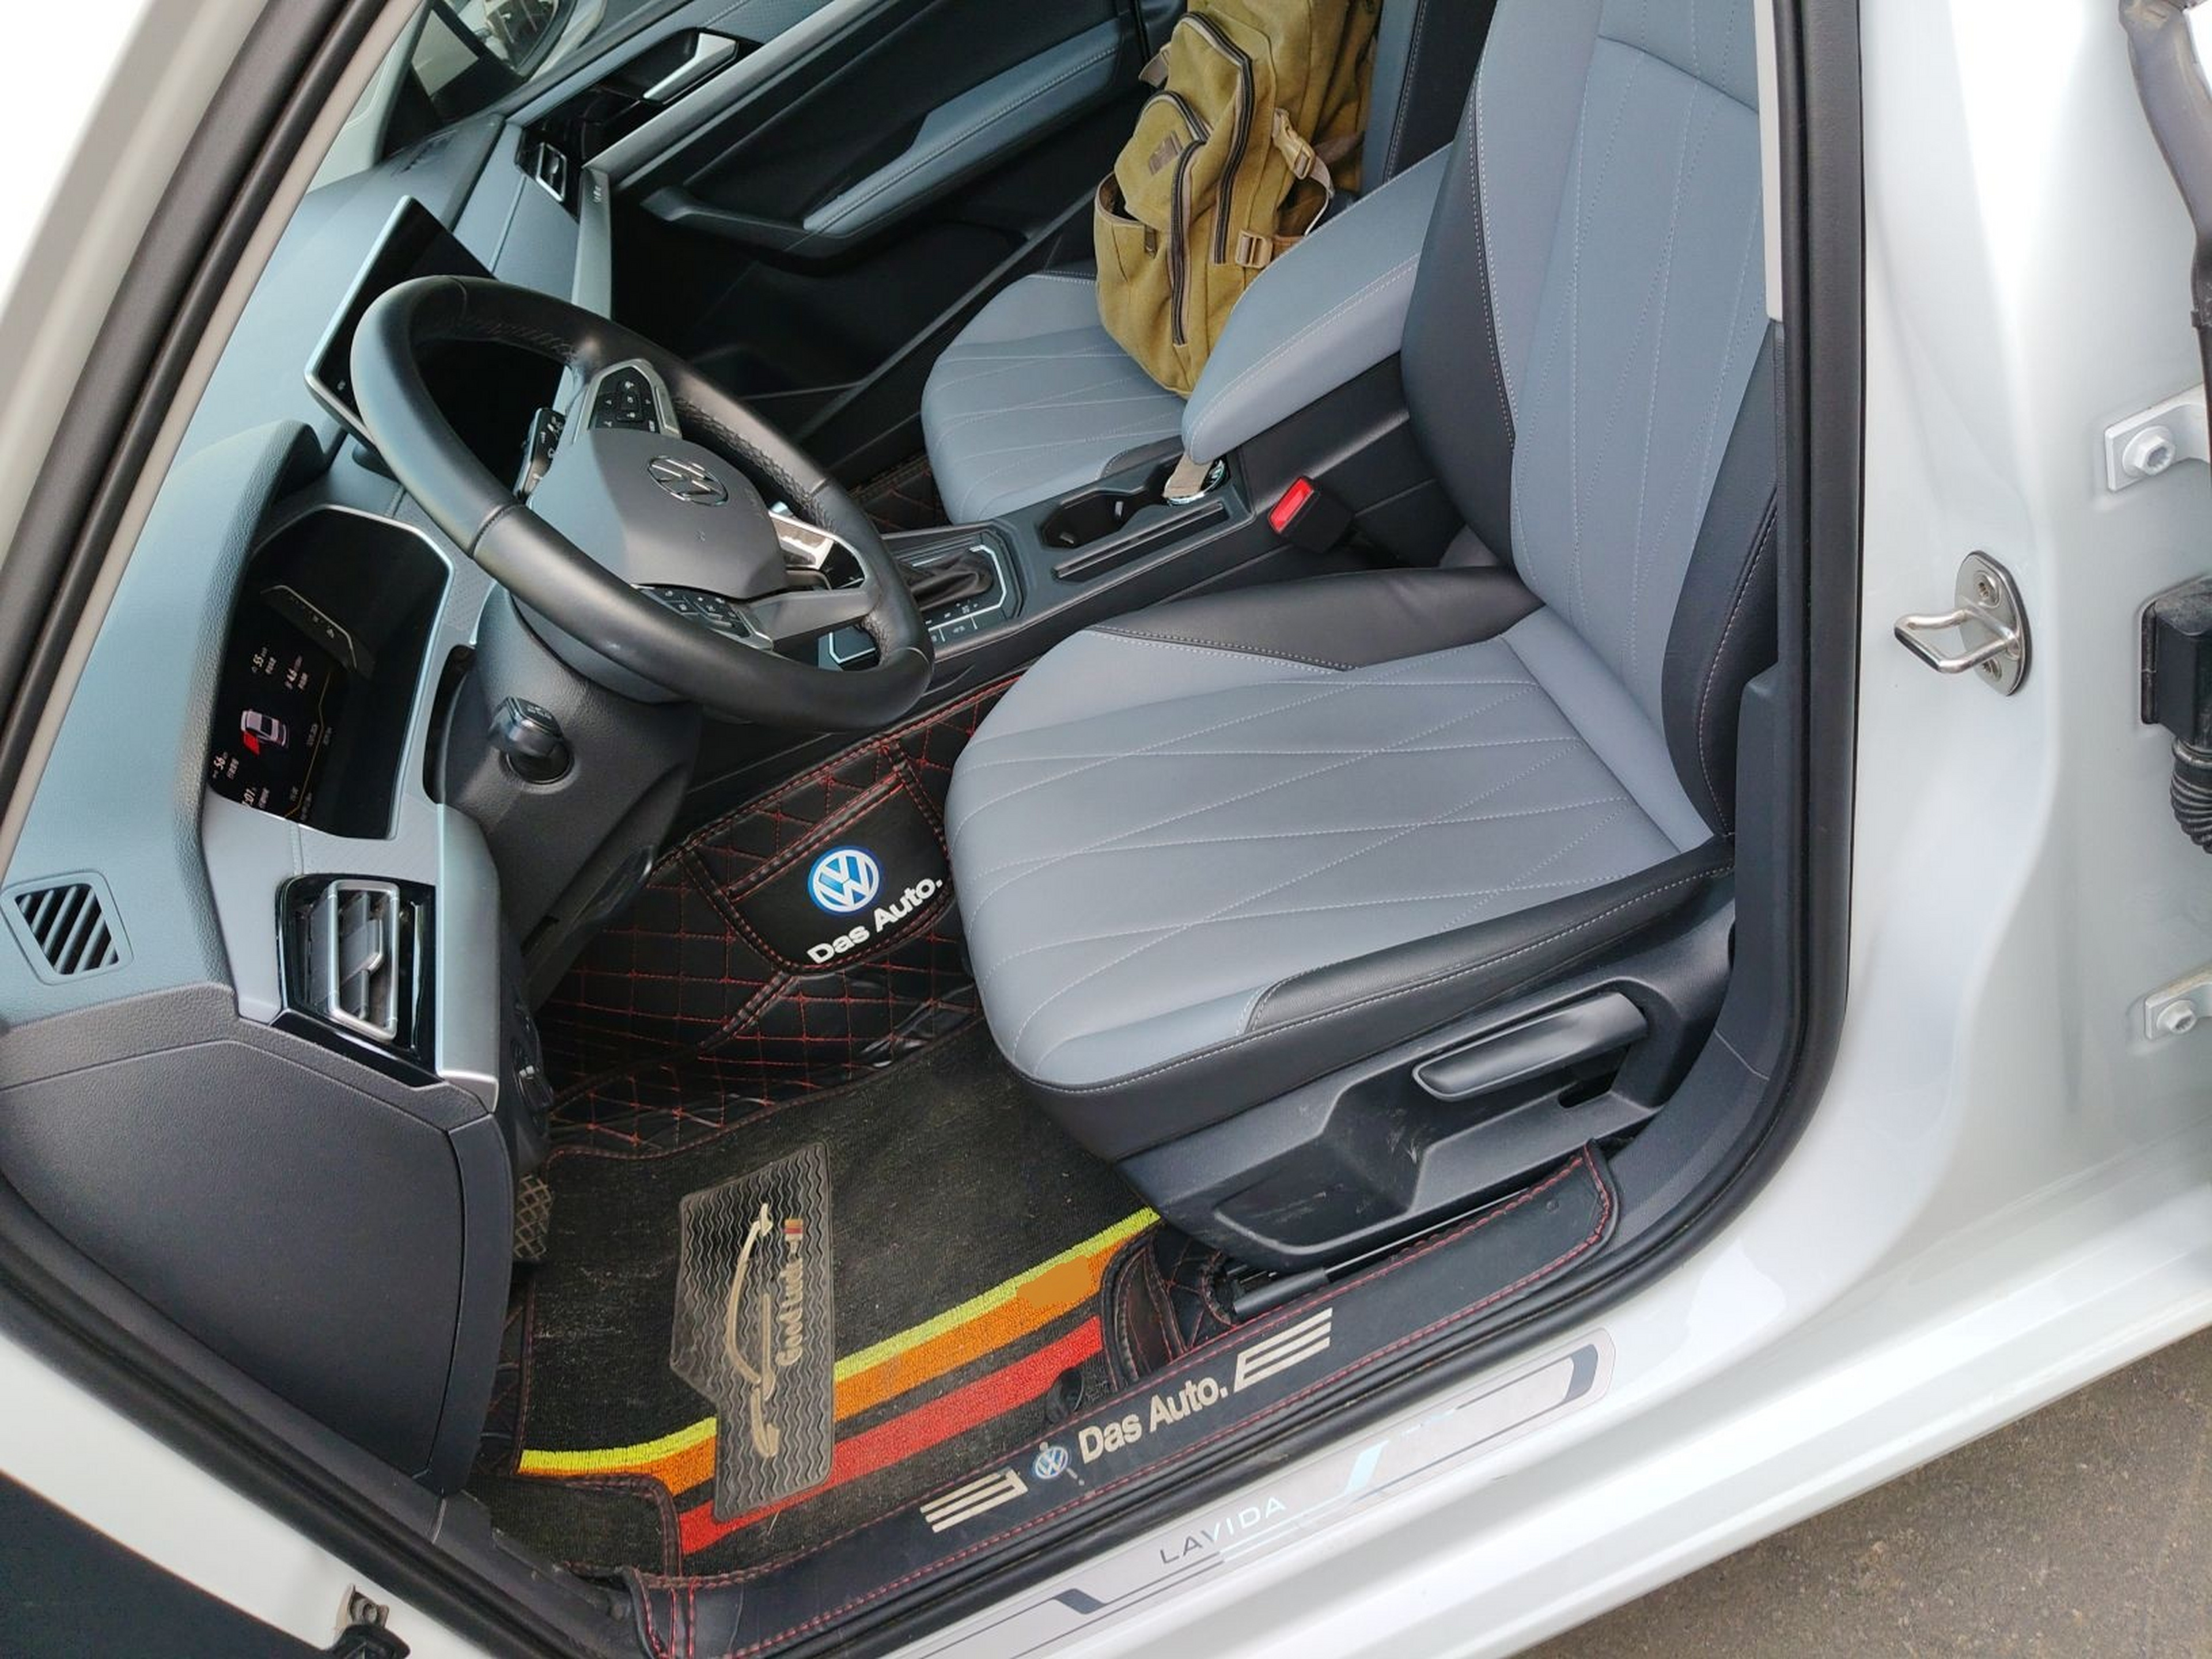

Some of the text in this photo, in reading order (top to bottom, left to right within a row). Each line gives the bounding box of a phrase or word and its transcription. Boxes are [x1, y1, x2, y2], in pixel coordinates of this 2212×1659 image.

[806, 876, 944, 965] Das Auto.
[775, 1308, 804, 1366] Good
[1078, 1377, 1229, 1464] Das Auto.
[1159, 1497, 1287, 1565] LAVIDA
